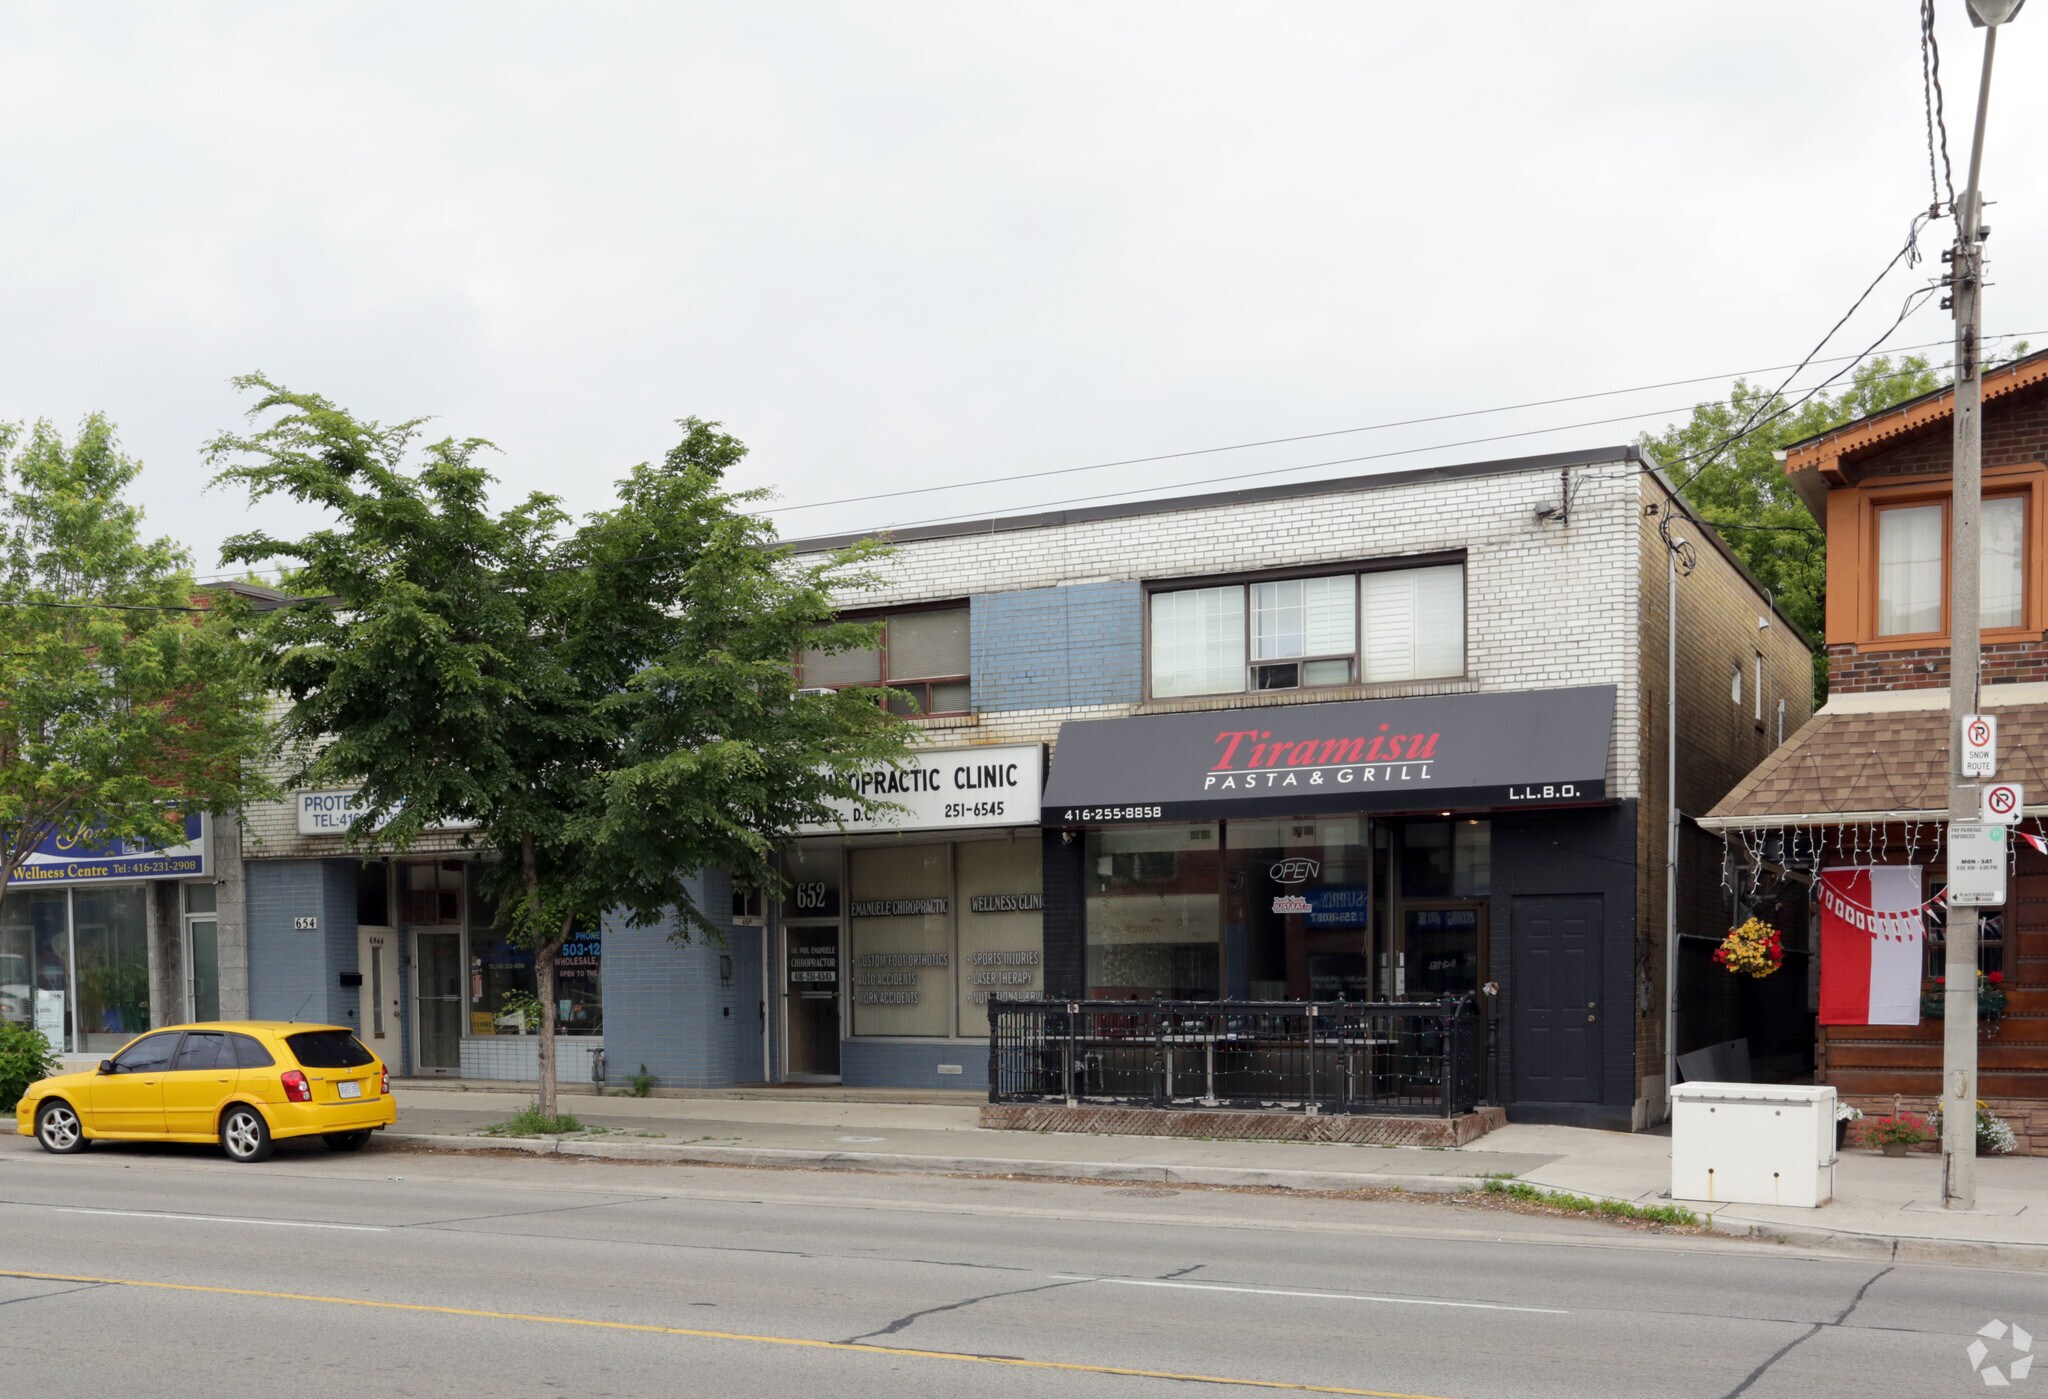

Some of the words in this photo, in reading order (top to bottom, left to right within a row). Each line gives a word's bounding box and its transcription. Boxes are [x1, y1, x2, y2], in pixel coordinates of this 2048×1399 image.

[1210, 723, 1440, 770] Tiramisu
[1969, 751, 1989, 759] SNOW
[1967, 762, 1990, 770] ROUTE
[954, 763, 1018, 790] CLINIC
[1204, 772, 1298, 790] PASTA
[1337, 765, 1431, 784] GRILL
[1509, 785, 1580, 800] L.L.B.O.
[945, 801, 1005, 818] 251-6545
[1064, 806, 1162, 821] 416-255-8858
[13, 866, 65, 880] Wellness
[67, 864, 109, 877] Centre
[133, 861, 196, 873] 416-231-2908
[1269, 861, 1320, 879] OPEN
[797, 882, 826, 908] 652
[852, 901, 890, 916] EMANUELE
[892, 899, 948, 914] CHIROPRACTIC
[972, 895, 1017, 912] WELLNESS
[1018, 894, 1044, 910] CLINI
[296, 918, 314, 929] 654
[575, 931, 600, 941] PHONE
[554, 957, 598, 967] WHOLESALE,
[791, 958, 836, 968] CHIROPRACTOR
[858, 955, 888, 967] CUSTOM
[888, 955, 906, 967] FOOT
[908, 954, 948, 967] ORTHOTICS
[972, 953, 1001, 966] SPORTS
[1003, 952, 1039, 965] INJURIES
[794, 972, 833, 981] 416-251-6545
[858, 974, 875, 986] AUTO
[877, 973, 917, 986] ACCIDENTS
[973, 972, 996, 985] LASER
[999, 971, 1032, 984] THERAPY
[858, 992, 878, 1004] WORK
[880, 991, 919, 1004] ACCIDENTS
